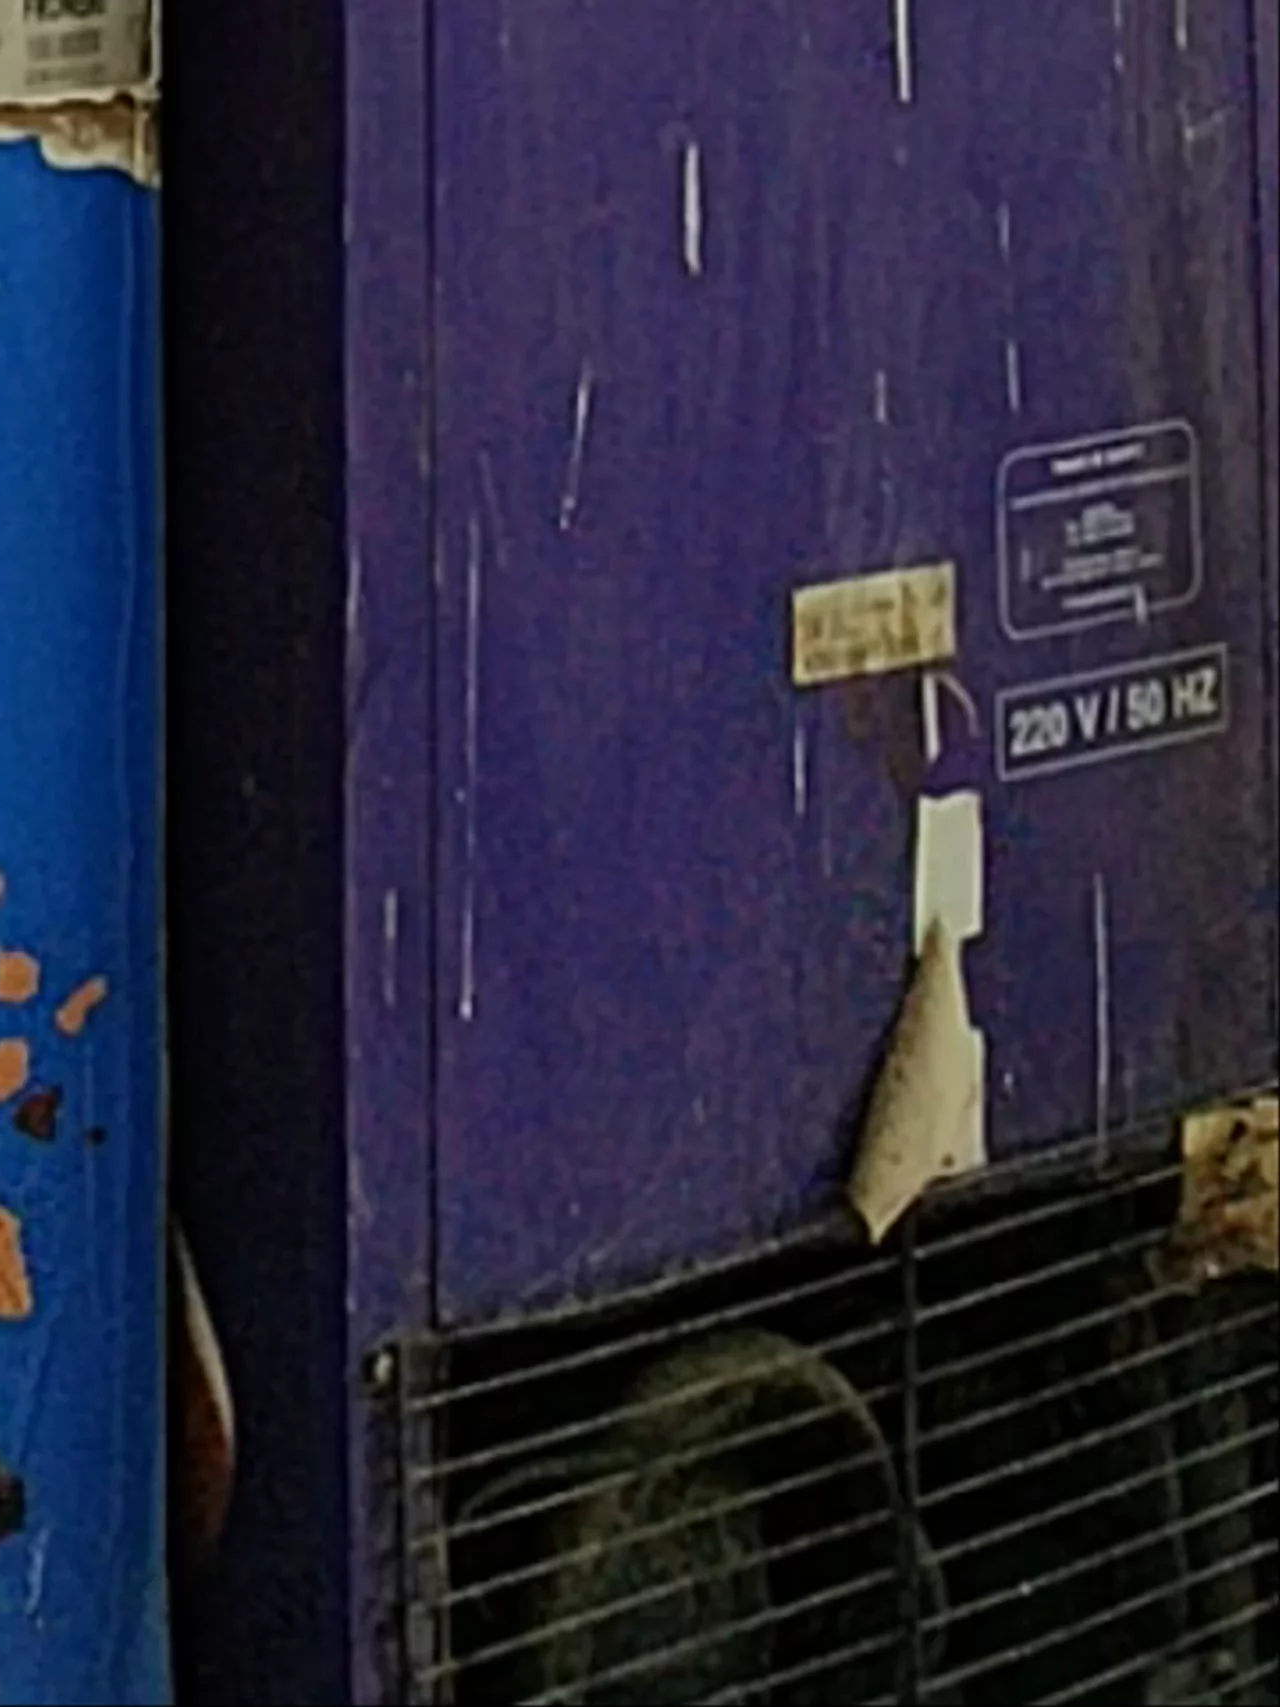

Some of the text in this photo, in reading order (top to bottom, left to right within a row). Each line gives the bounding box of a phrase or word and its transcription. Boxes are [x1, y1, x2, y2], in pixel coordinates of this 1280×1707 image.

[1009, 701, 1068, 757] 220
[1074, 693, 1100, 742] V
[1106, 685, 1120, 734] /
[1126, 679, 1166, 730] 50
